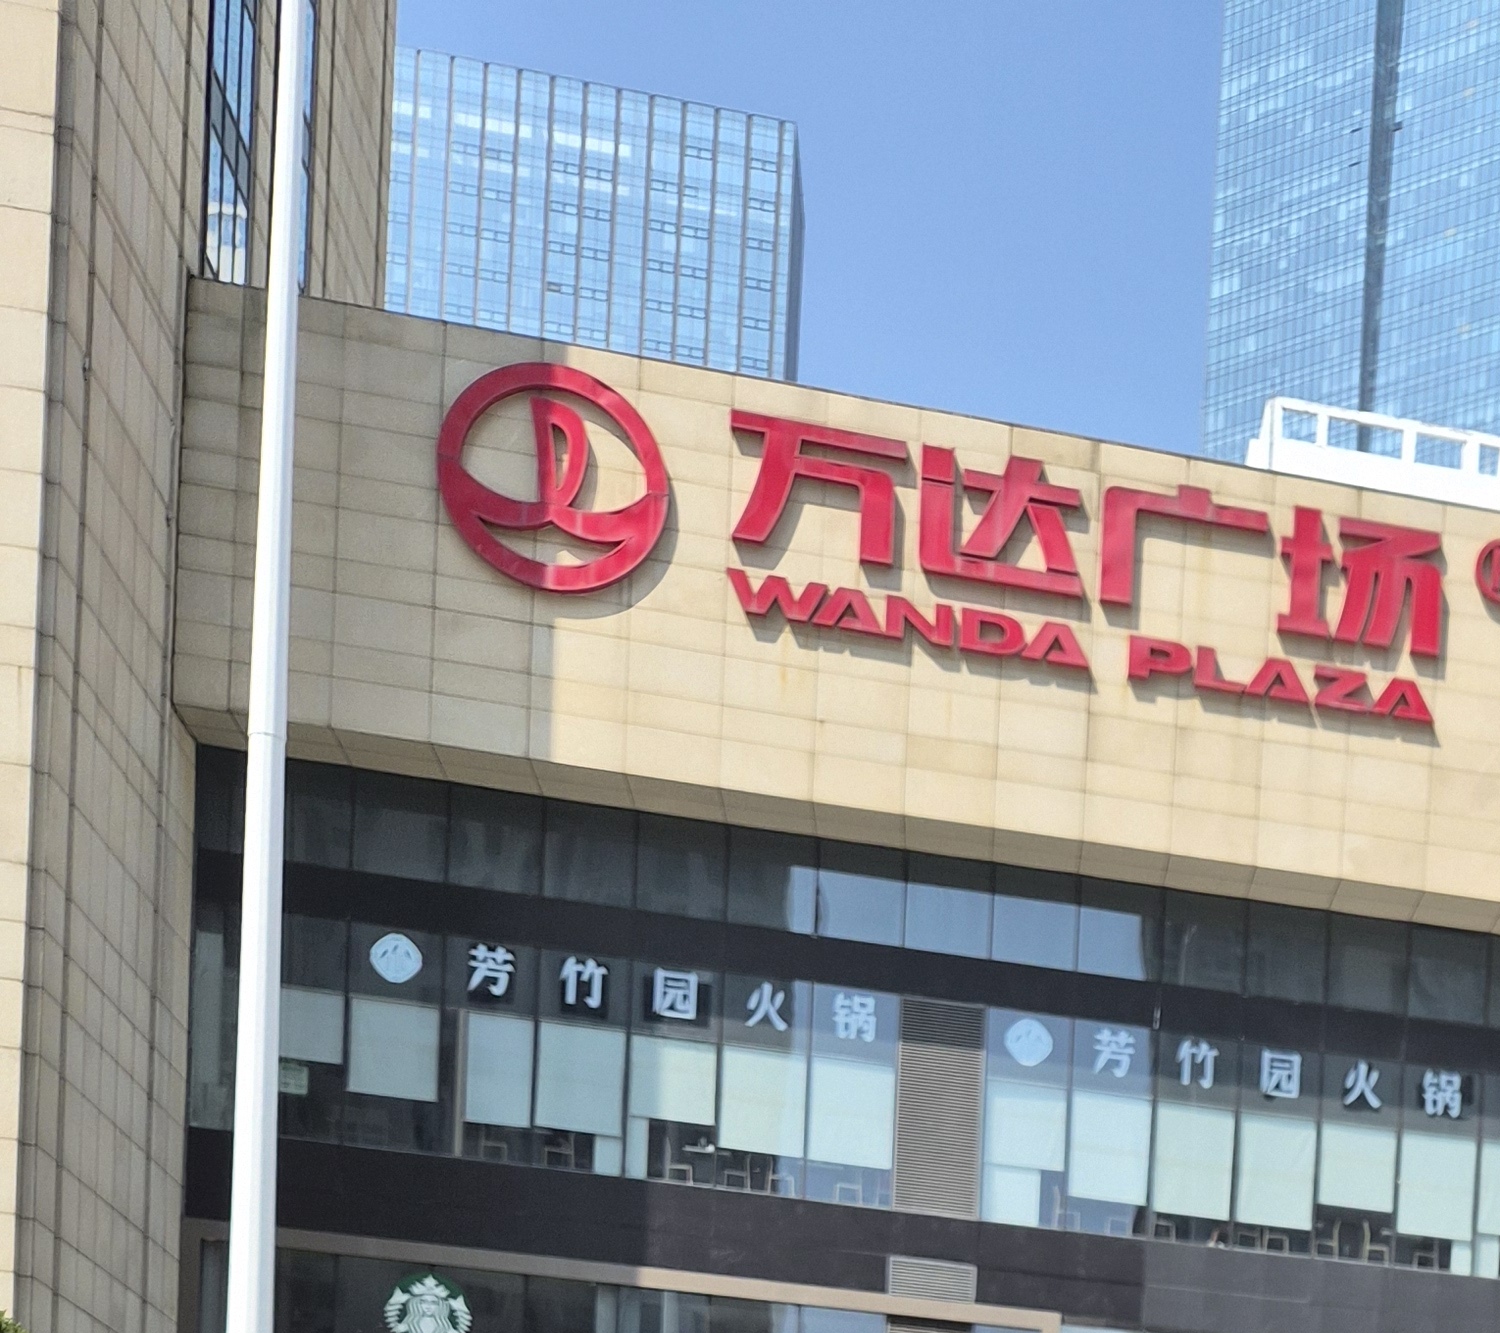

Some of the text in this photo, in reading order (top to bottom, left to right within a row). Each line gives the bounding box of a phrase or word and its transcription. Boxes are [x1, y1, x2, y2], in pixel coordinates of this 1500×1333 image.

[730, 408, 1443, 658] 万达广场
[726, 566, 1434, 727] WANDA PLAZA
[466, 943, 877, 1043] 芳竹园火锅
[1091, 1027, 1464, 1120] 芳竹园火锅
